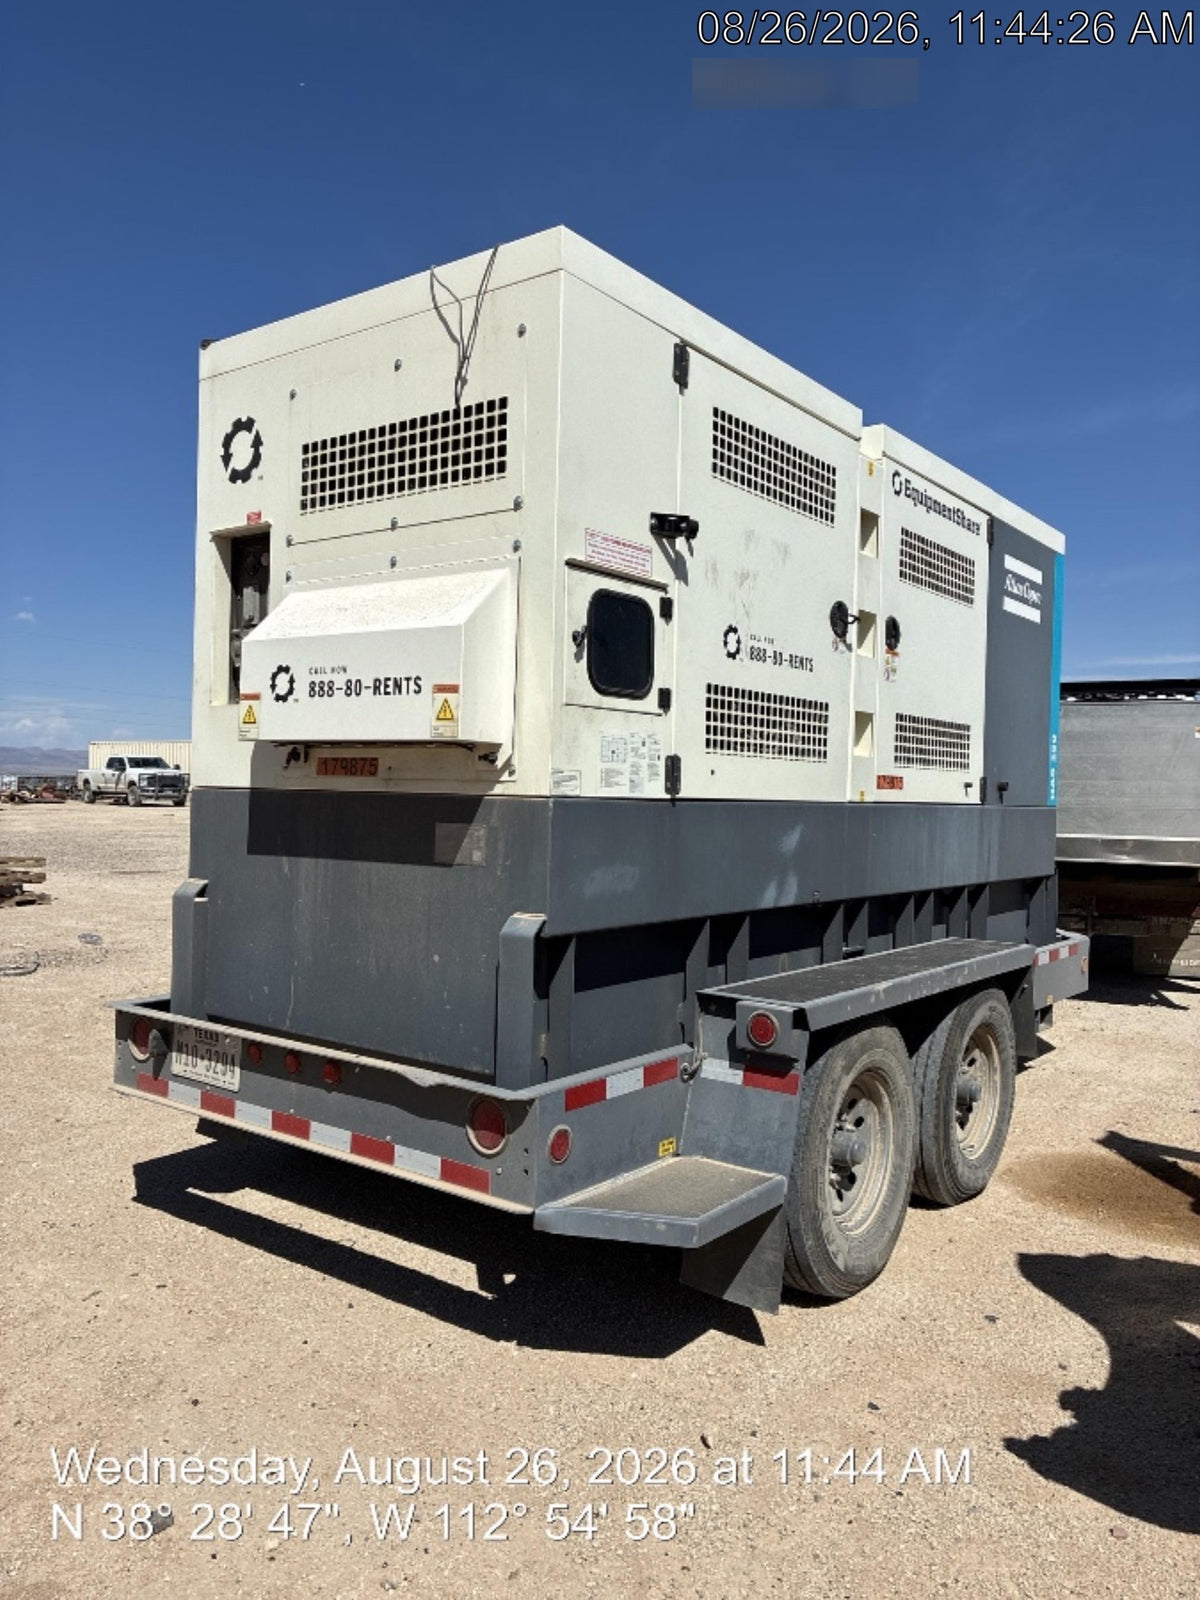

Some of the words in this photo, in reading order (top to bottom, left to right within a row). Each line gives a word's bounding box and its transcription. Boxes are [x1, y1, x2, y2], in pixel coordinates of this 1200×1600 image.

[904, 478, 981, 536] EquipmentShare
[749, 645, 814, 673] 888-80-RENTS
[308, 675, 423, 698] 888-80-RENTS
[321, 757, 378, 776] 179875
[193, 1027, 220, 1042] TEXAS
